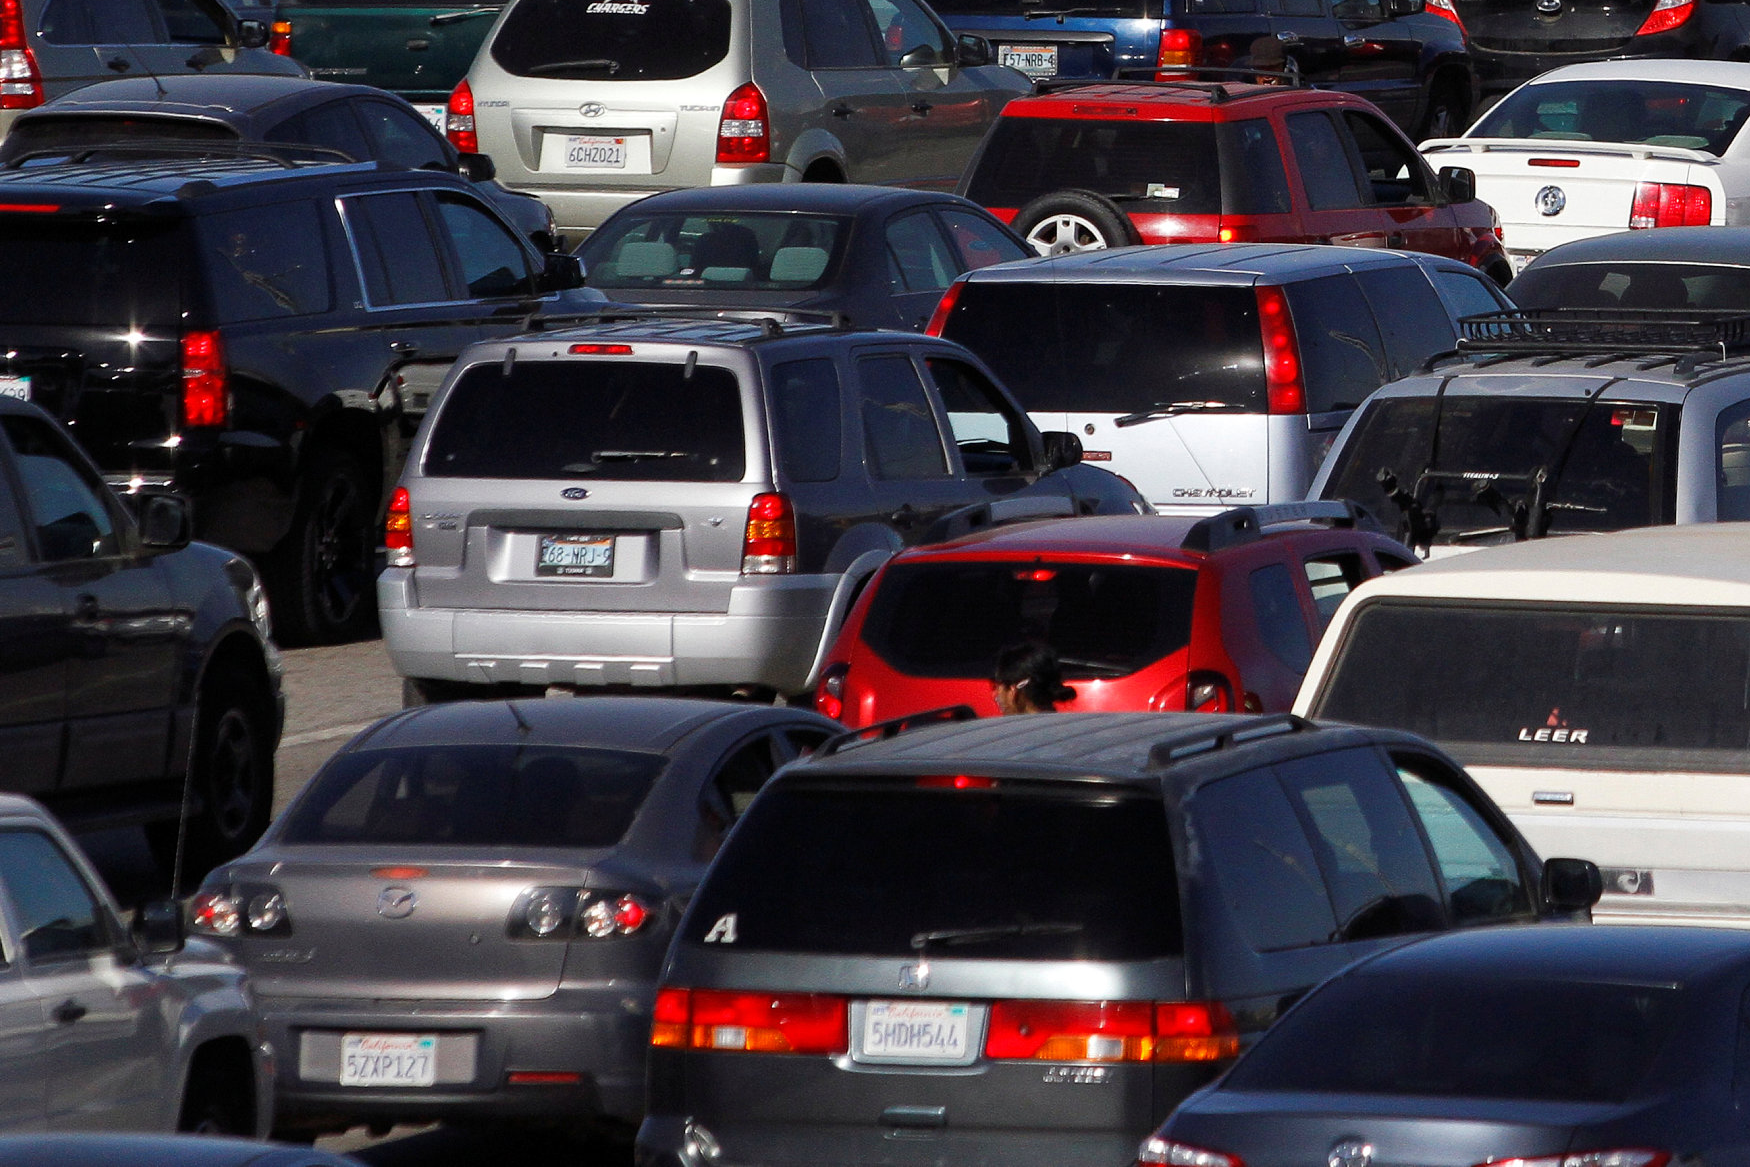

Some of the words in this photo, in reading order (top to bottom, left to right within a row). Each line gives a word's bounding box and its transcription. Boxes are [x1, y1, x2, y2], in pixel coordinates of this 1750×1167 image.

[586, 2, 650, 15] CHARGERS
[568, 147, 621, 164] 6CHZ021
[1518, 727, 1589, 744] LEER
[703, 912, 738, 943] A
[886, 1007, 946, 1021] California
[871, 1021, 959, 1048] 5HDH544
[346, 1053, 430, 1080] 5ZXP127
